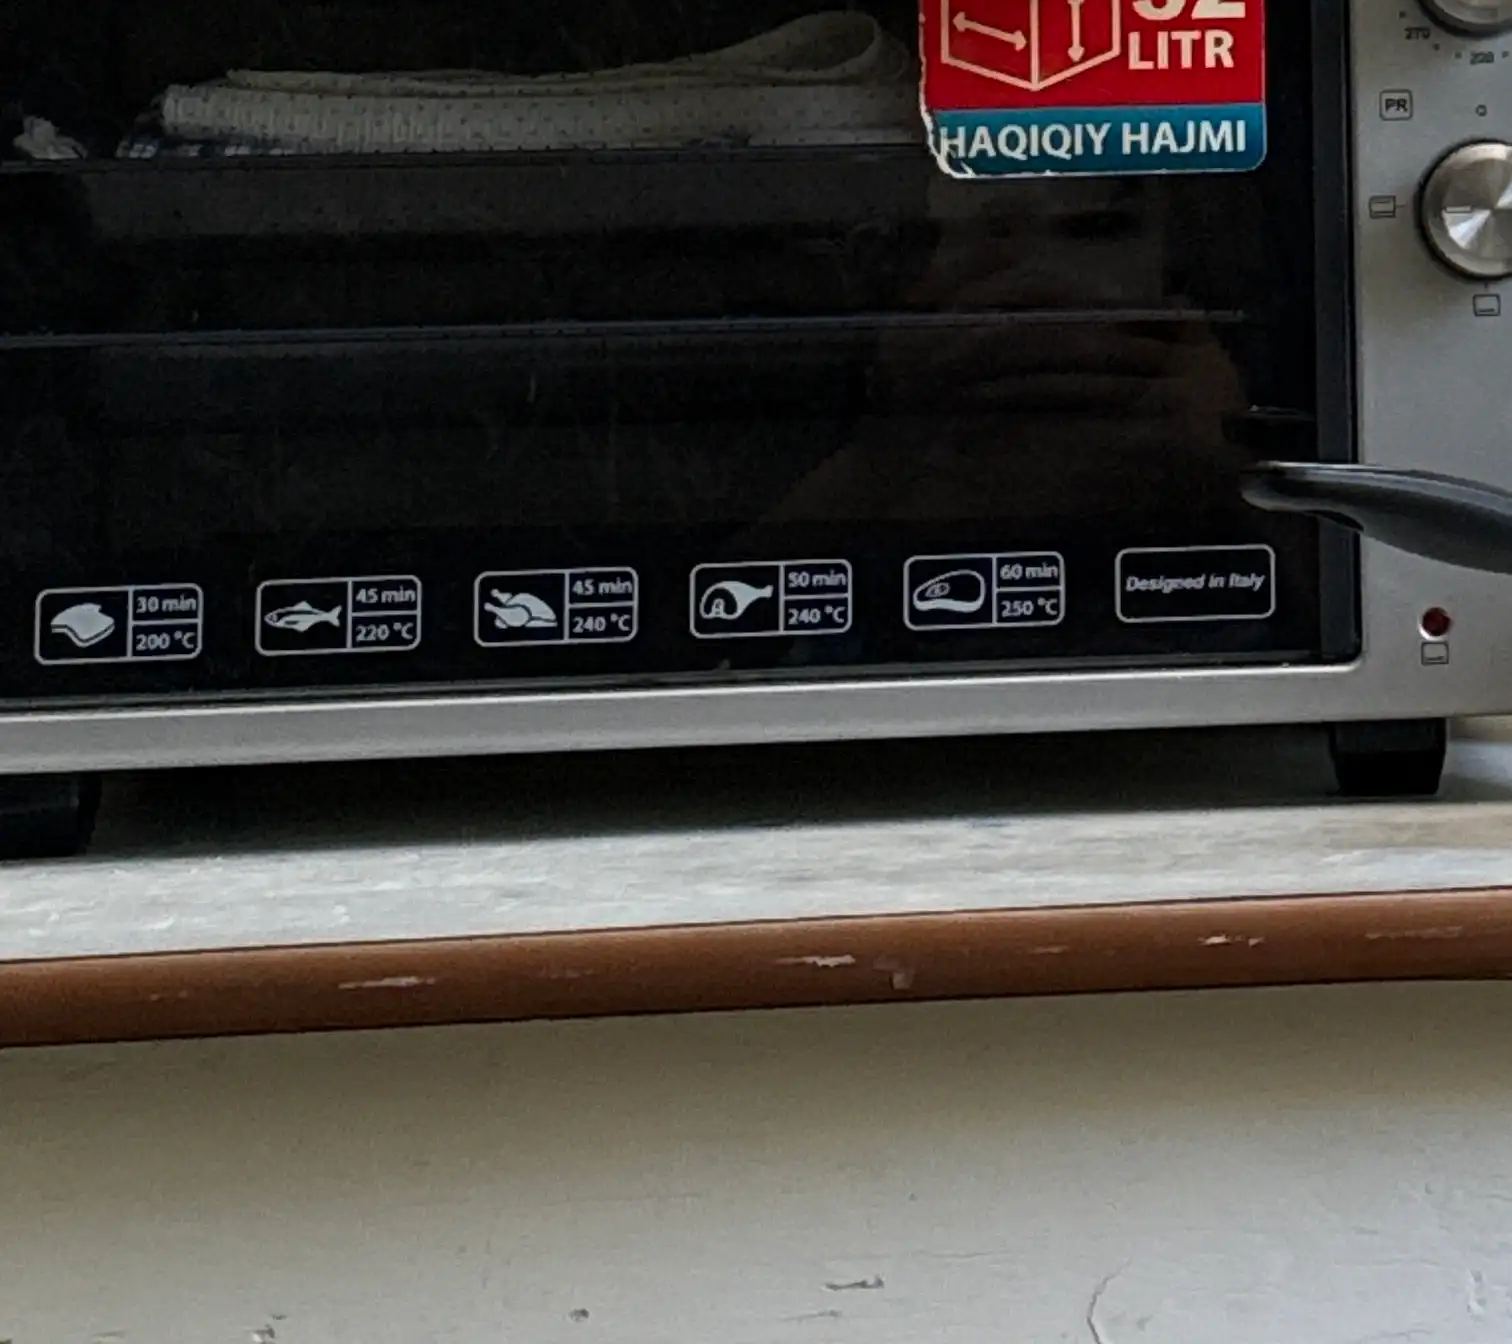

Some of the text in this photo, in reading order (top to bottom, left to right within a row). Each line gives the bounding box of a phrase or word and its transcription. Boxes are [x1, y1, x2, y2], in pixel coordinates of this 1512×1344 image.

[1128, 29, 1235, 70] LITR
[1385, 98, 1408, 113] PR
[941, 119, 1246, 161] HAQIQIY HAJMI
[812, 569, 846, 587] min
[1000, 562, 1058, 580] 60 min
[572, 576, 633, 595] 45 min
[1126, 572, 1265, 594] Designed in Italy
[136, 593, 197, 613] 30 min
[356, 585, 416, 604] 45 min
[788, 608, 821, 625] 240
[1001, 600, 1034, 617] 250
[356, 623, 390, 642] 220
[572, 616, 607, 634] 240
[136, 633, 170, 651] 200
